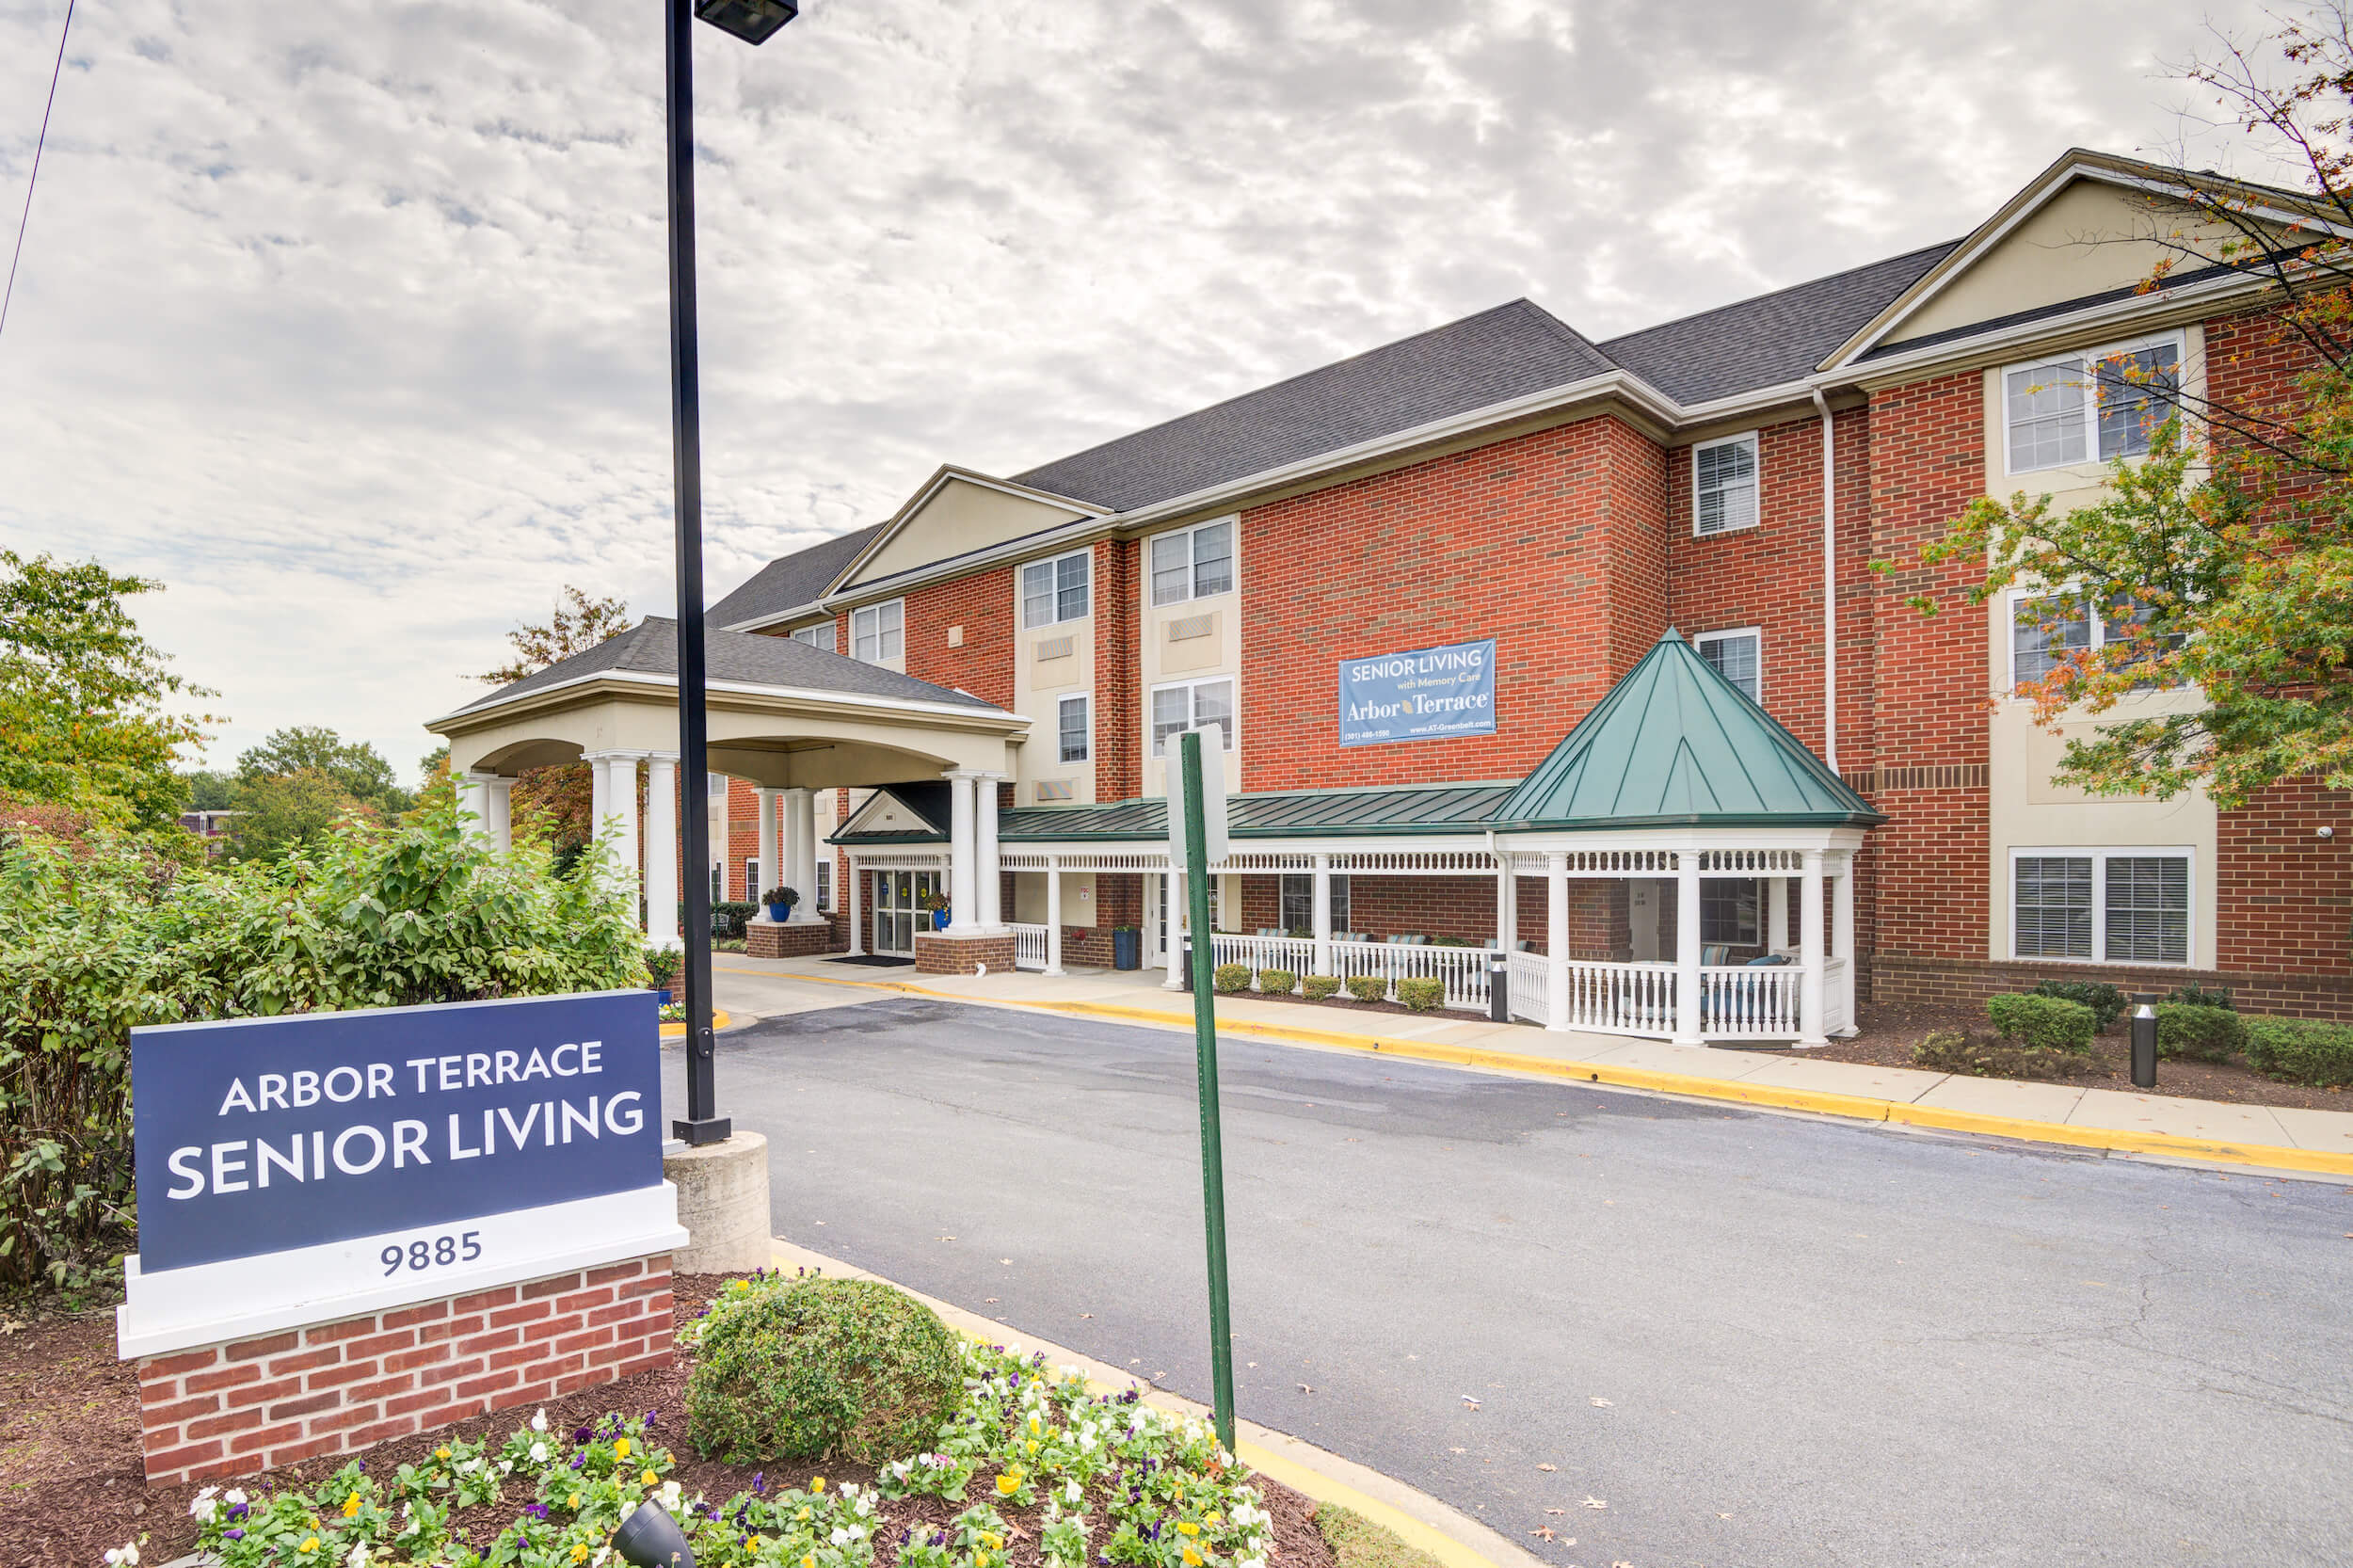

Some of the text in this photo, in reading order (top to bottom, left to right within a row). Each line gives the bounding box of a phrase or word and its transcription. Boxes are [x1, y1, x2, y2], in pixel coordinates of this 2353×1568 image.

[1352, 649, 1482, 682] SENIOR LIVING
[1397, 671, 1481, 690] with Memory Care
[1347, 694, 1486, 722] Arbor Terrace
[217, 1040, 603, 1116] ARBOR TERRACE
[166, 1091, 645, 1200] SENIOR LIVING
[380, 1230, 482, 1277] 9885
